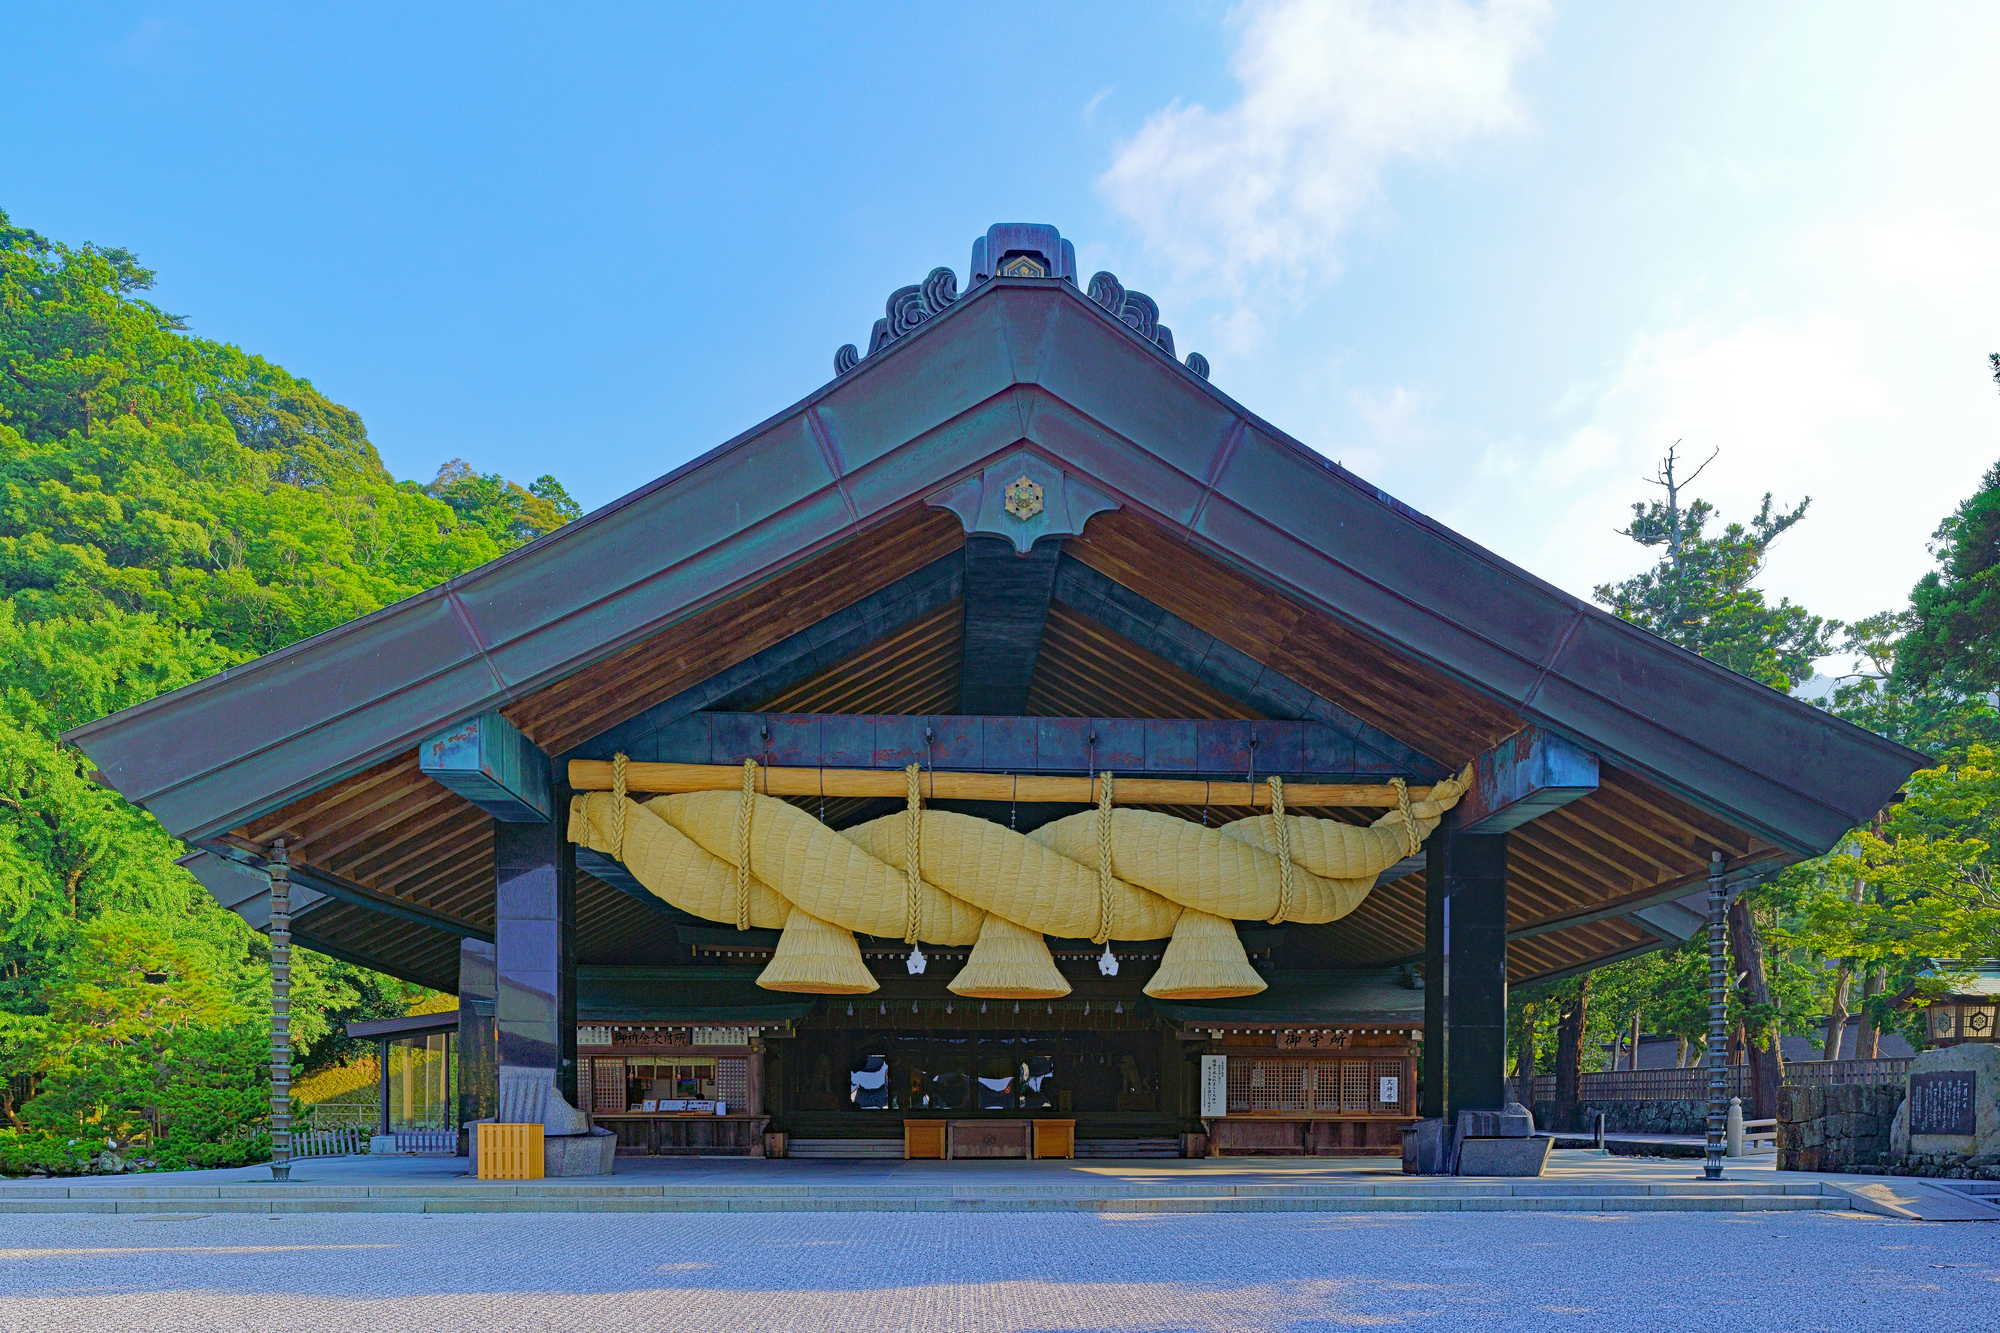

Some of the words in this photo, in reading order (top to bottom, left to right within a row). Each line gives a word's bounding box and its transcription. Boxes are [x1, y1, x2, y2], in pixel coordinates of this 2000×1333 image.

[614, 1032, 686, 1044] 御祈念受付所
[1284, 1033, 1347, 1048] 御守所
